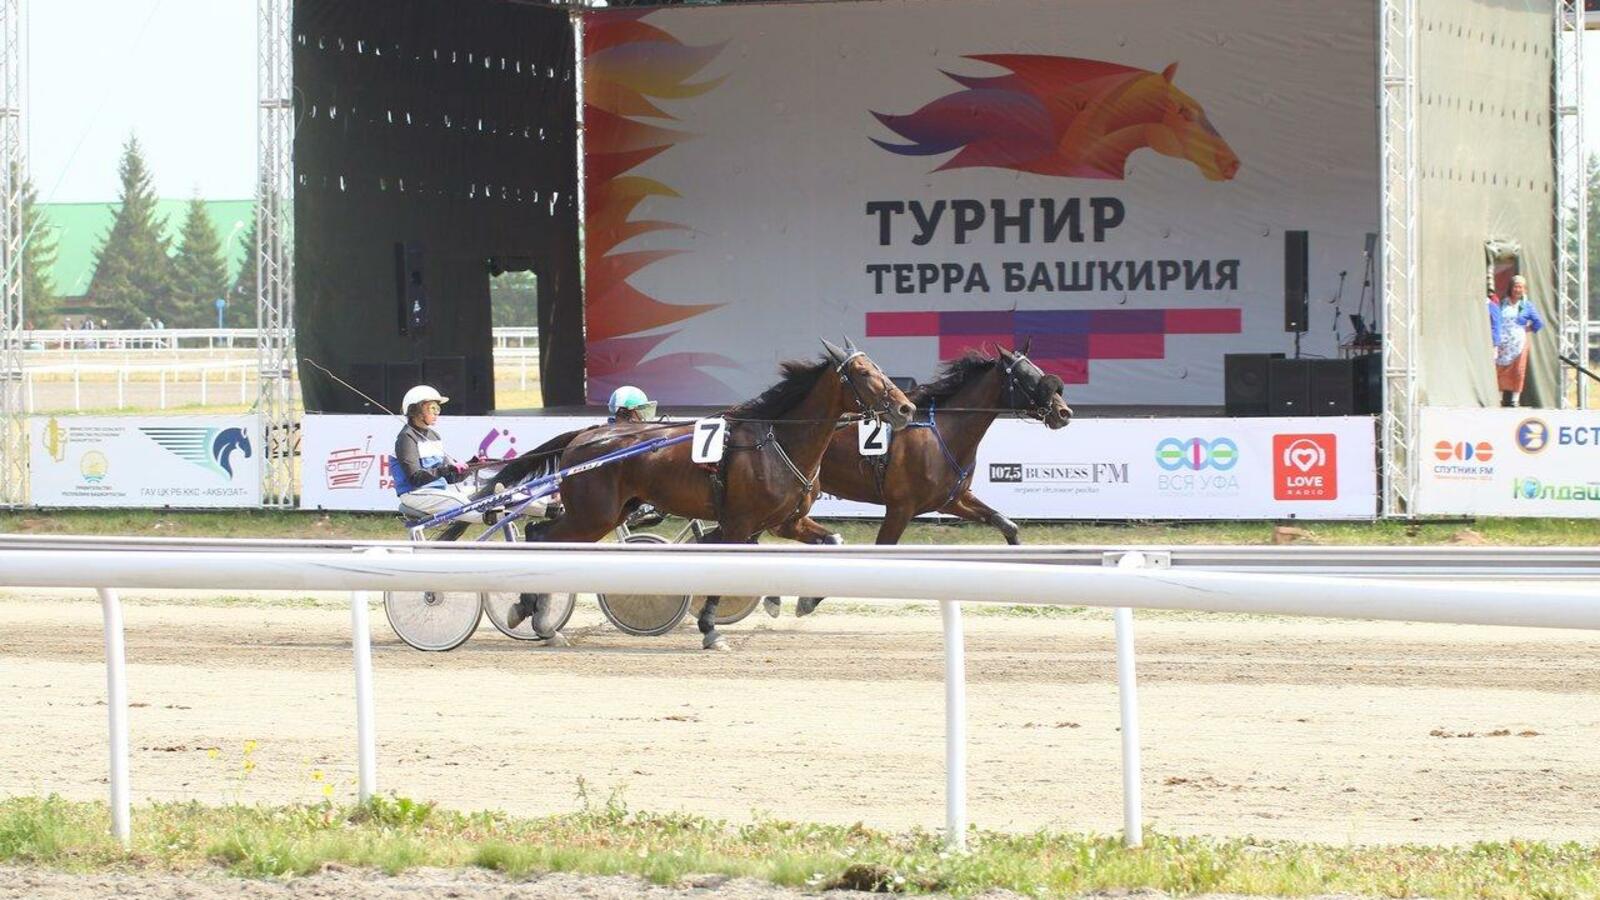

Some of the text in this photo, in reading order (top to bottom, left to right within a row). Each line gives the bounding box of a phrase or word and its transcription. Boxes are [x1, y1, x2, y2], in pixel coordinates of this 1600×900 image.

[865, 196, 1126, 246] ТУРНИР
[865, 258, 1241, 295] ТЕРРА БАШКИРИЯ
[700, 423, 721, 458] 7
[863, 419, 883, 450] 2
[1025, 467, 1089, 479] BUSINESS
[1092, 463, 1129, 483] FM
[1434, 465, 1494, 475] СПУТНИК FM
[140, 487, 157, 496] ГАУ
[1158, 475, 1240, 490] ВСЯ УФА
[1287, 476, 1323, 487] LOVE
